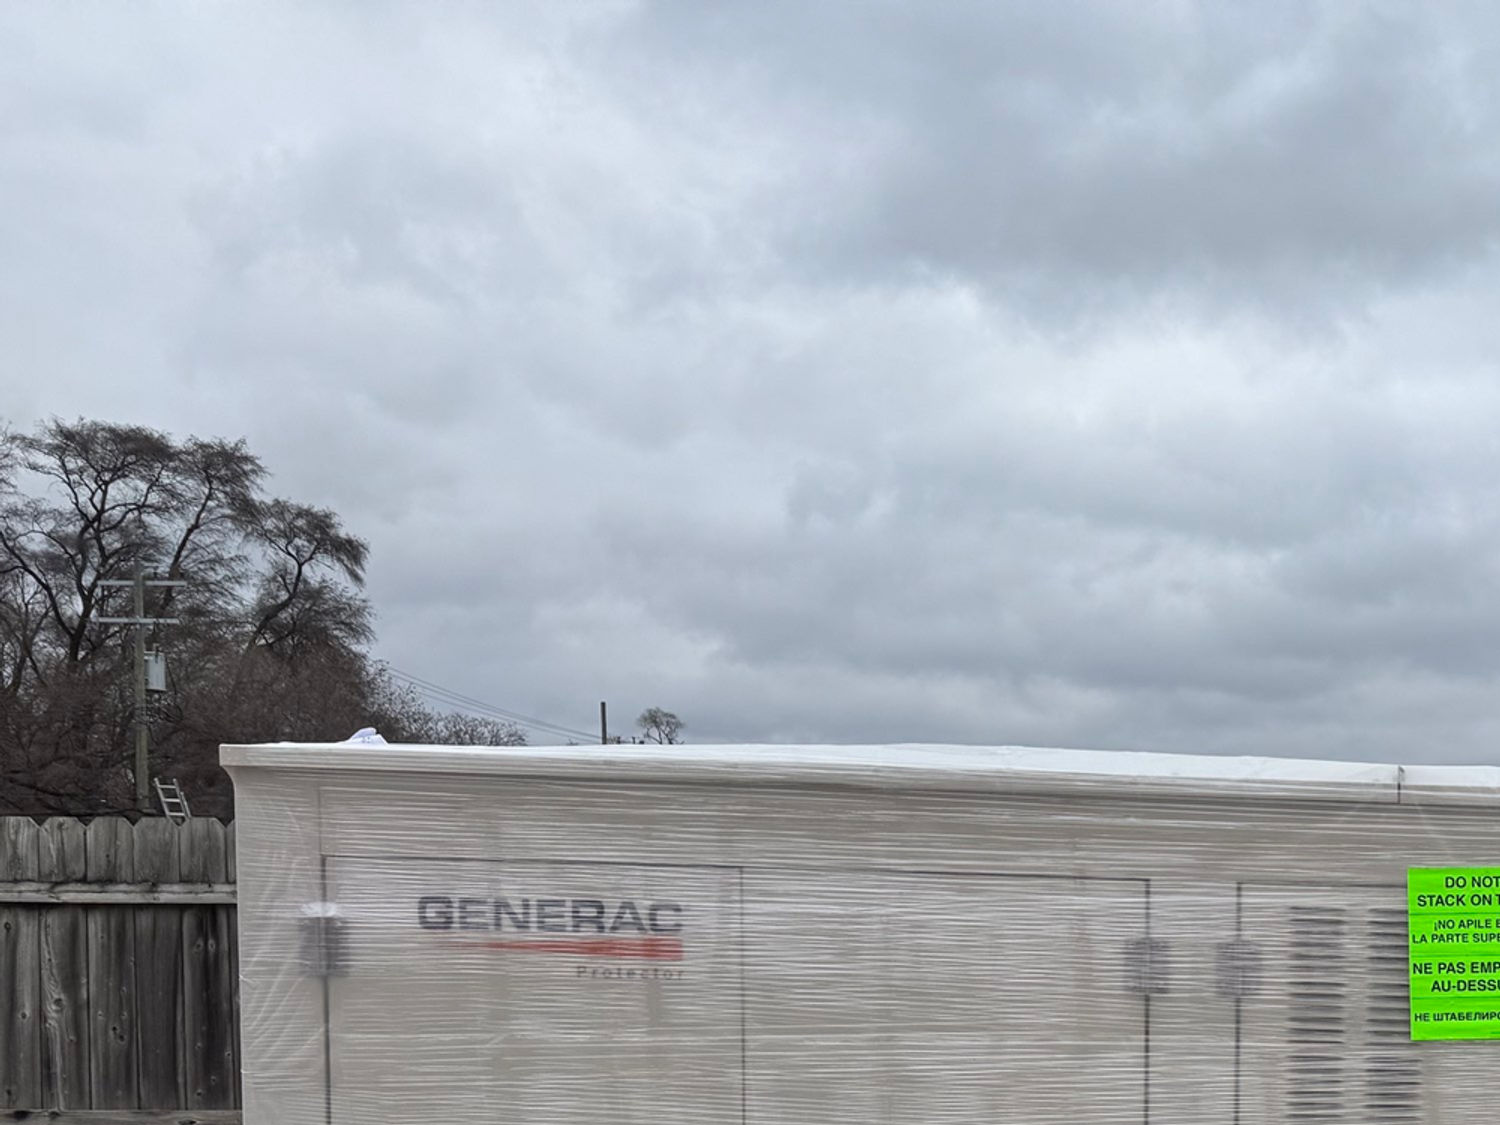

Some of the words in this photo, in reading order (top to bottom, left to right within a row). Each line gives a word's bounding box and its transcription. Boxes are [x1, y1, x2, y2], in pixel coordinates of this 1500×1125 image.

[1444, 876, 1467, 888] DO
[1417, 894, 1466, 907] STACK
[1470, 894, 1492, 906] ON
[417, 896, 683, 933] GENERAC
[1434, 919, 1455, 931] ¡NO
[1458, 919, 1492, 929] APILE
[1412, 934, 1427, 944] LA
[1431, 933, 1468, 943] PARTE
[577, 966, 685, 980] Protector
[1412, 962, 1432, 974] NE
[1438, 962, 1466, 974] PAS
